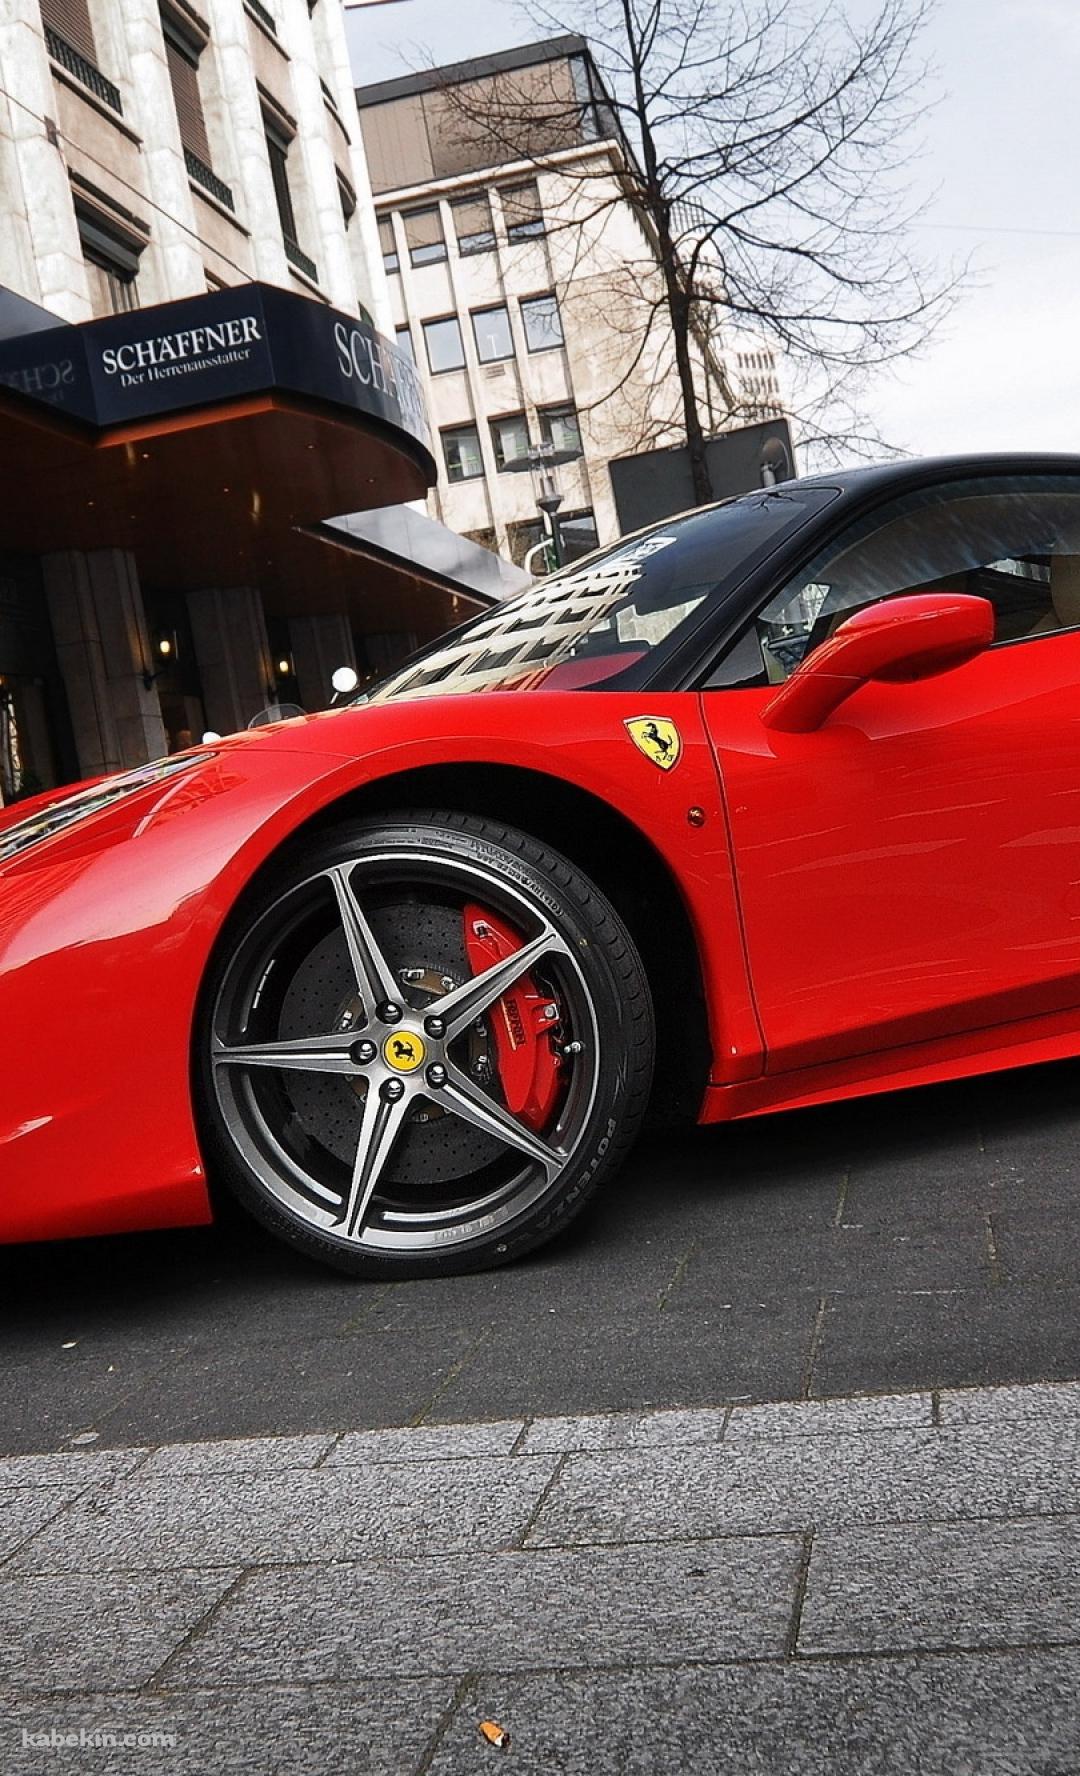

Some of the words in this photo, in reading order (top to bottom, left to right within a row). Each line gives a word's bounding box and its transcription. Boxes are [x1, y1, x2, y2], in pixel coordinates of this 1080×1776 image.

[102, 316, 262, 374] SCHÄFFNER
[120, 371, 145, 388] Der
[147, 349, 251, 381] Herrenausstatter
